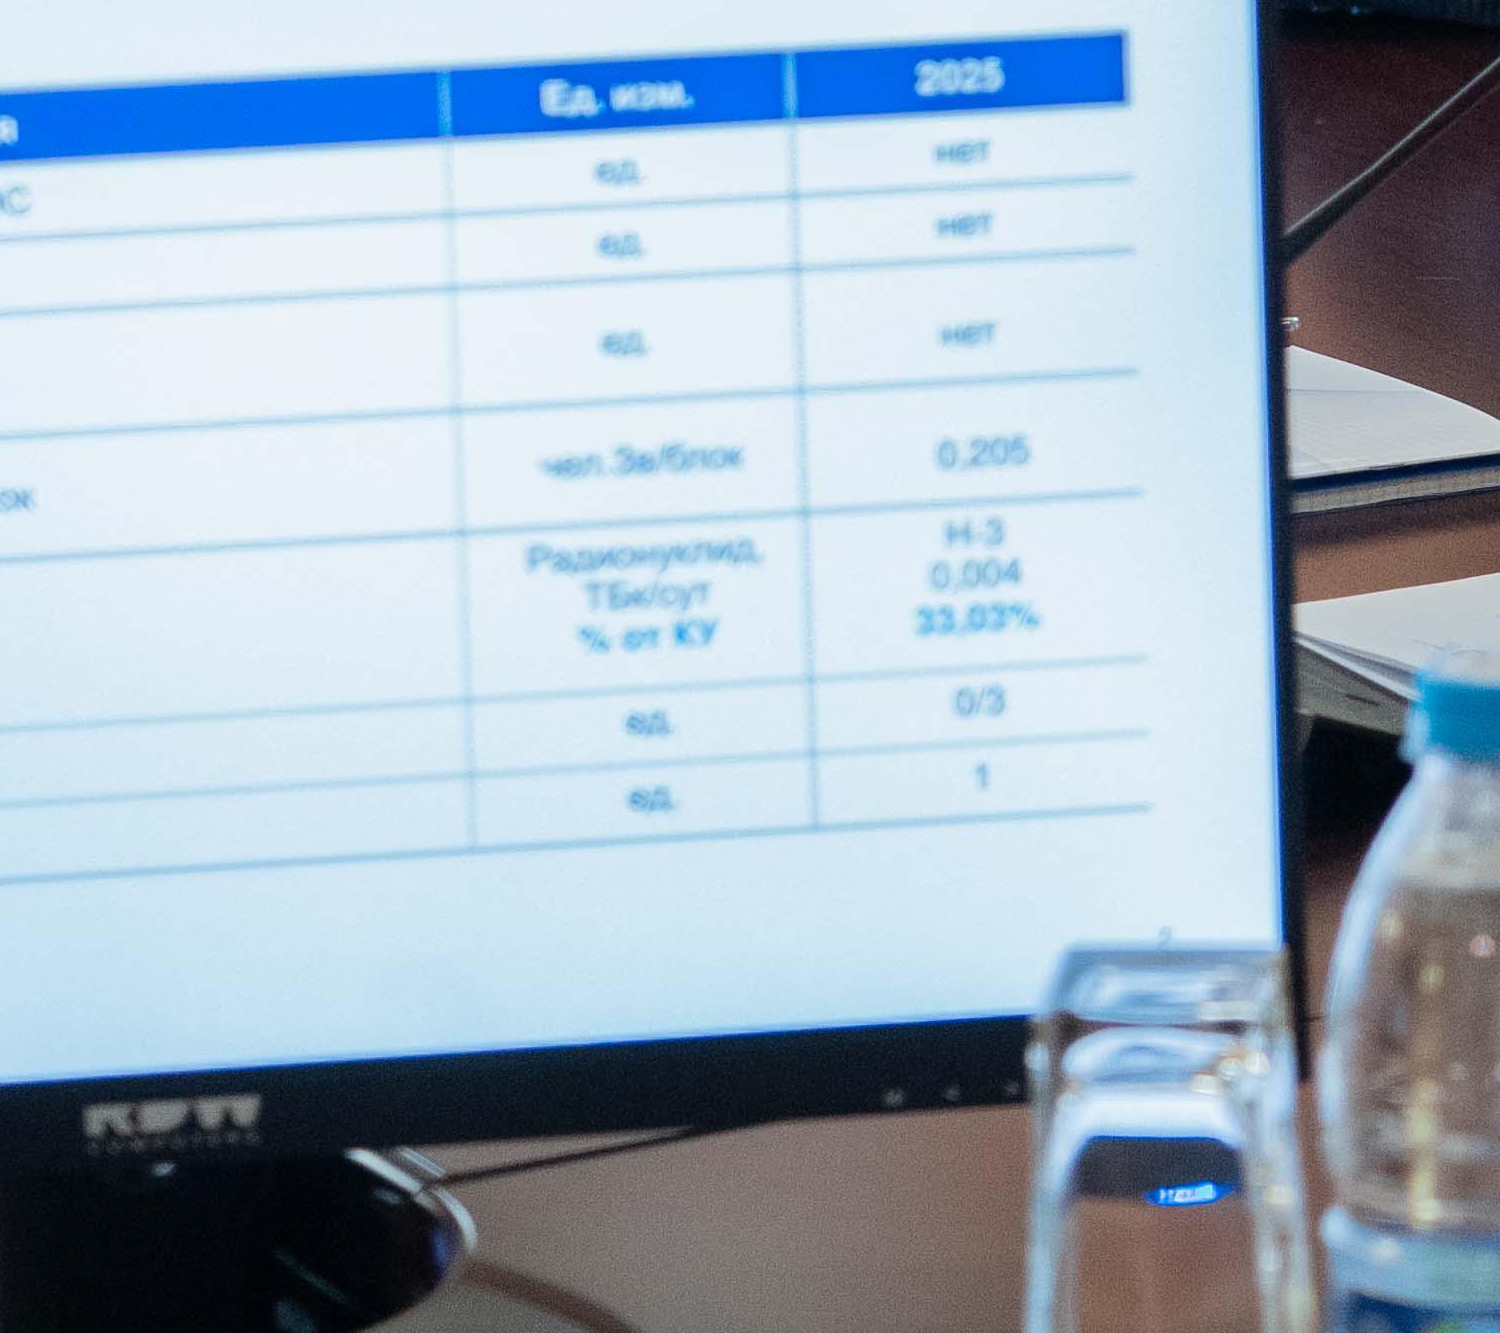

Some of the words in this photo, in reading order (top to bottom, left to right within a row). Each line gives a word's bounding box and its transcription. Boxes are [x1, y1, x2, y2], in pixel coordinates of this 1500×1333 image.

[914, 55, 1004, 98] 2025
[609, 79, 696, 113] изм.
[934, 140, 991, 164] нет
[936, 213, 995, 238] нет
[939, 322, 998, 347] нет
[929, 557, 1023, 592] 0,004
[577, 625, 611, 653] %
[622, 626, 660, 651] от
[674, 618, 720, 648] КУ
[915, 601, 1040, 637] 33,03%
[951, 685, 1006, 719] 0/3
[974, 761, 992, 790] 1
